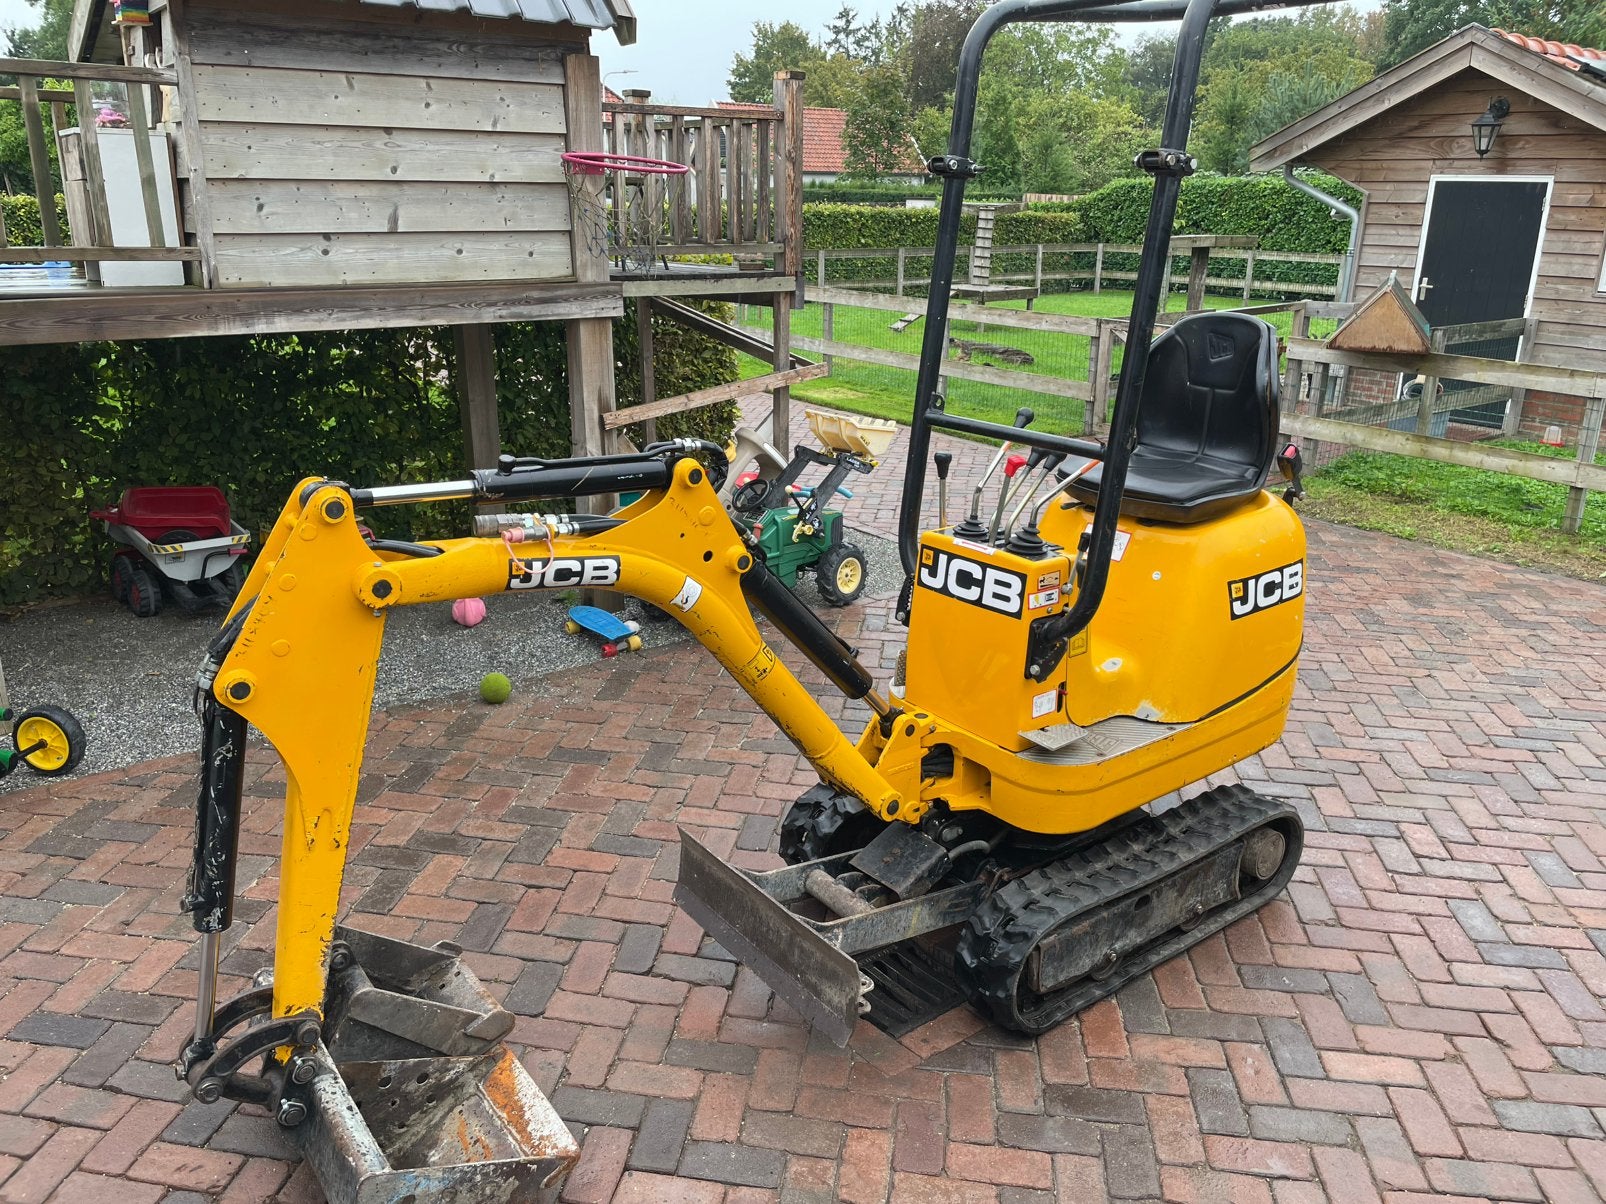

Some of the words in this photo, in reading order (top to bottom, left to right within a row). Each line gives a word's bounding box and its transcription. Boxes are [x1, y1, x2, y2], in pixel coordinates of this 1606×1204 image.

[509, 558, 619, 589] JCB
[920, 553, 1022, 614] JCB
[1232, 562, 1303, 616] JCB
